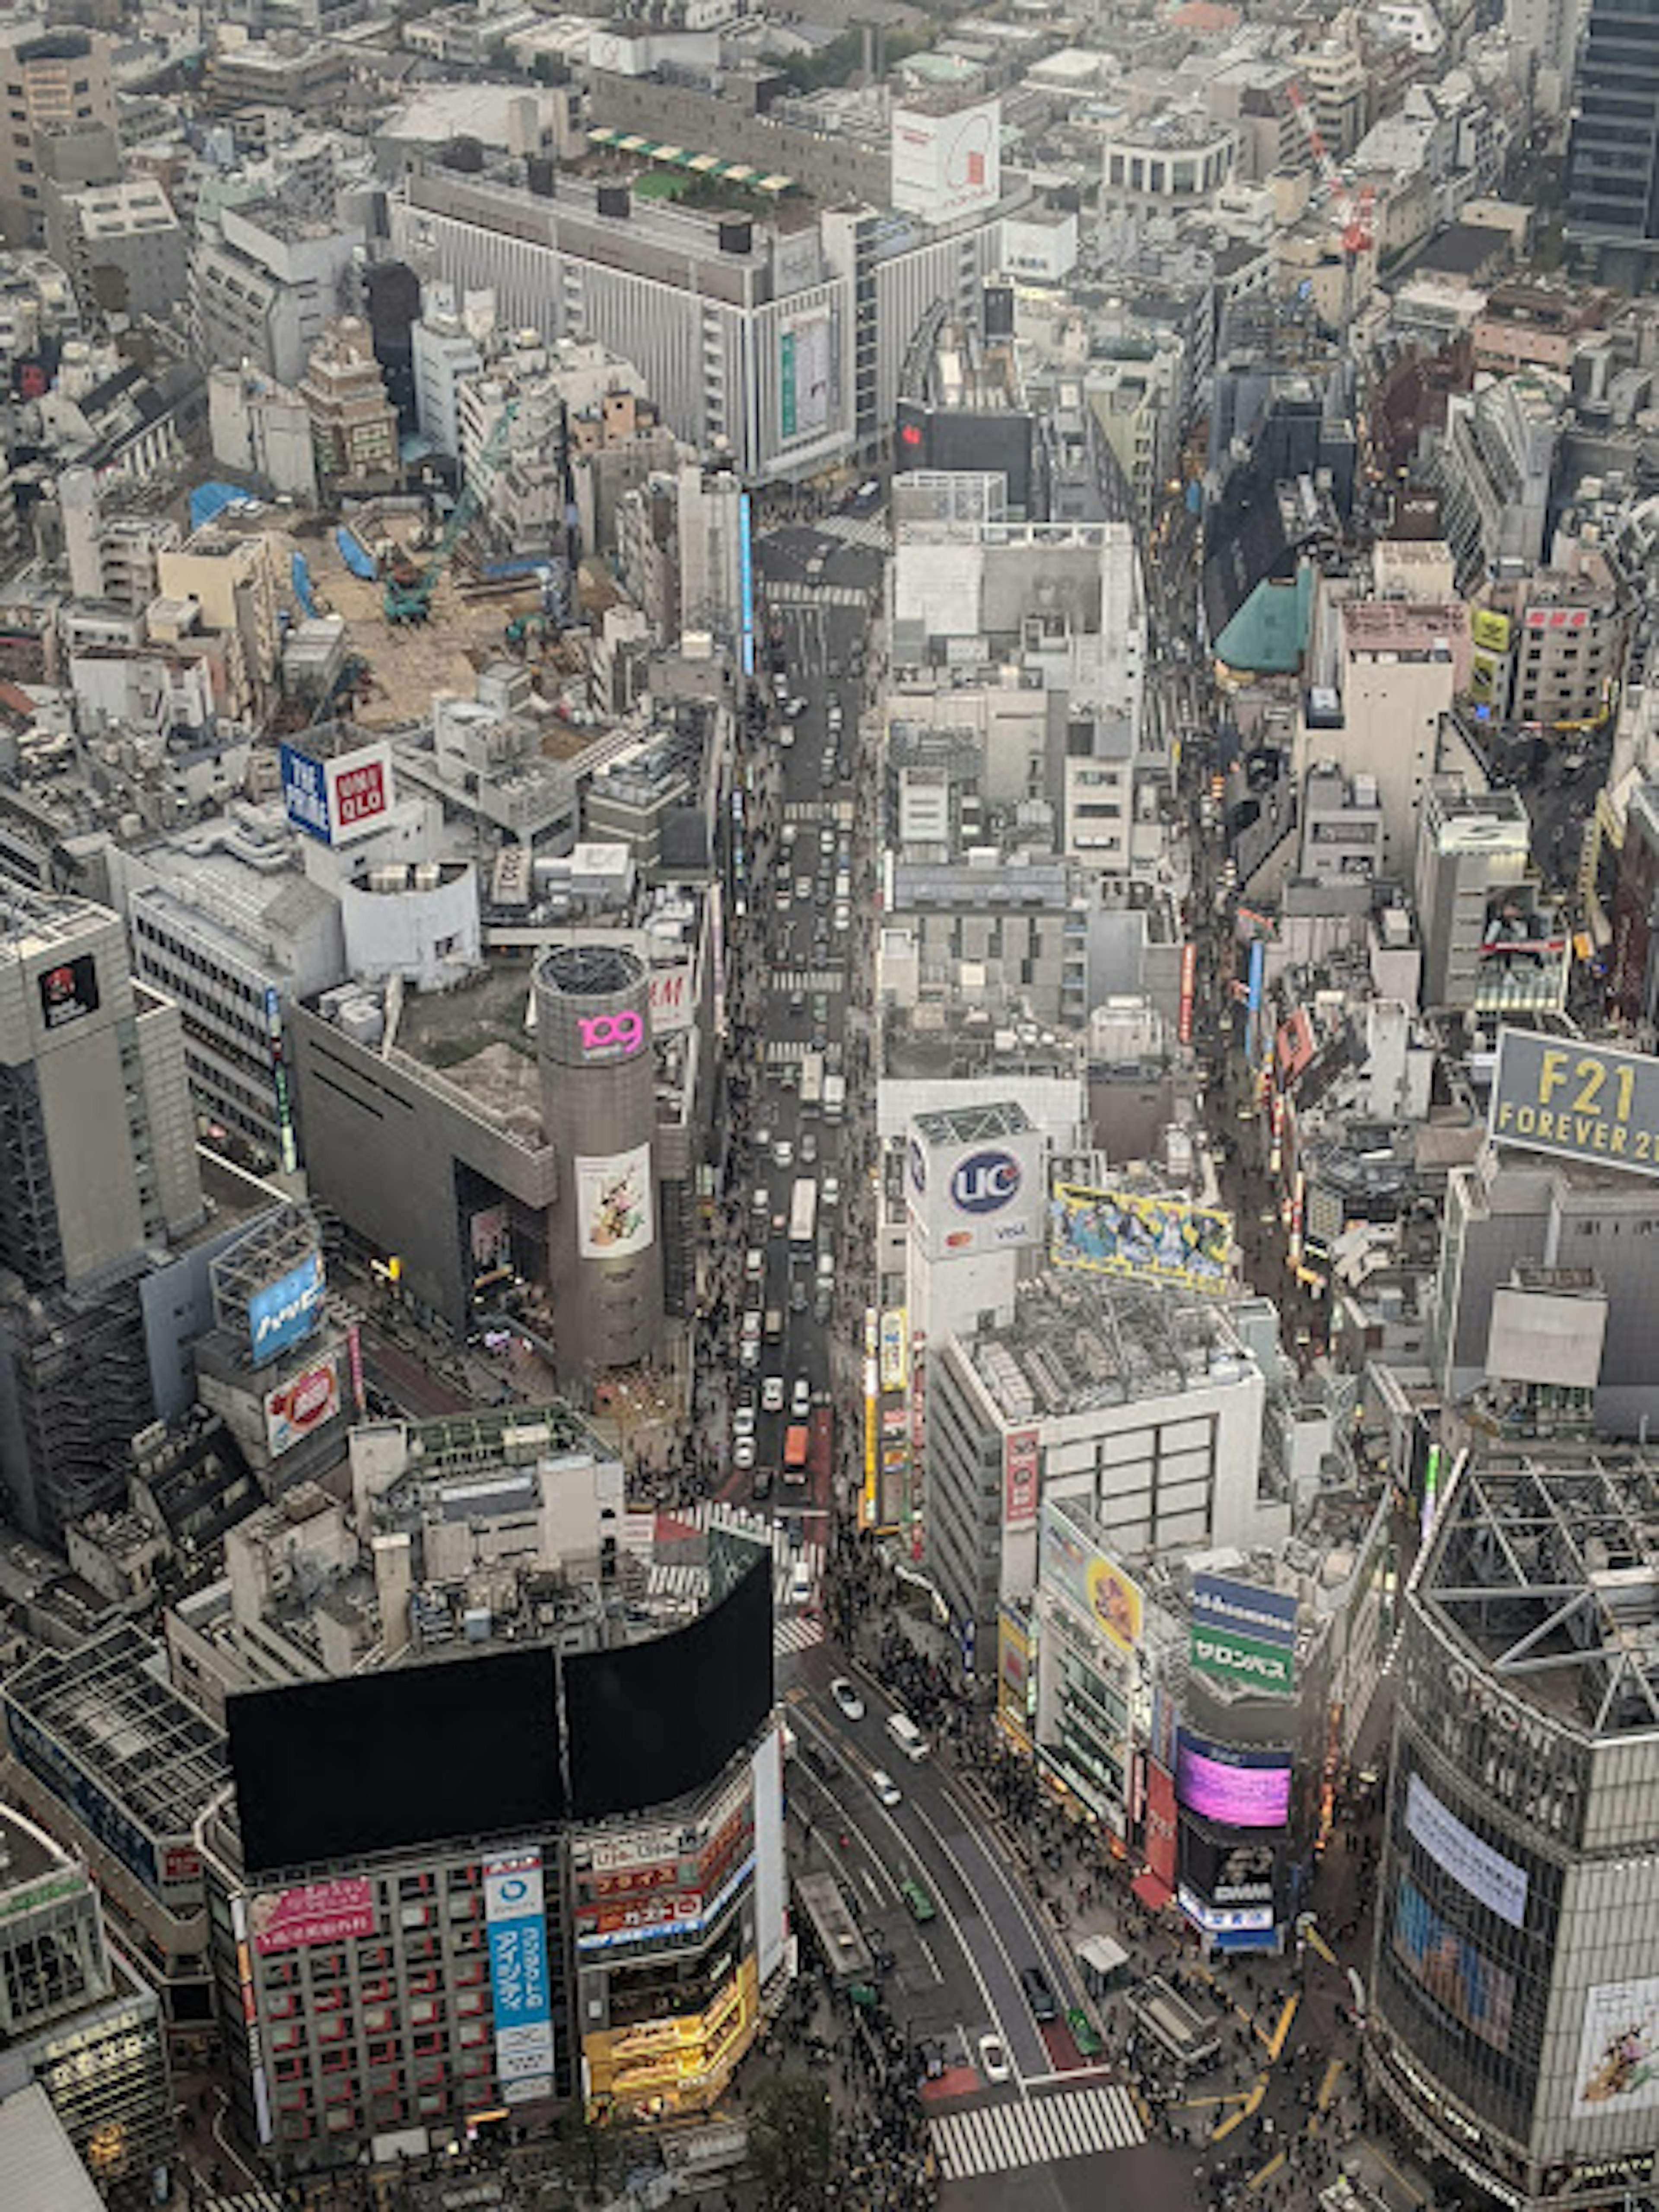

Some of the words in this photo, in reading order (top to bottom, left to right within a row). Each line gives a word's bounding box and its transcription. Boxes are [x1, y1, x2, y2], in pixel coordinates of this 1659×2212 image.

[342, 791, 382, 820] QLO
[575, 1010, 643, 1053] 109
[1538, 1050, 1635, 1122] F21
[1500, 1101, 1627, 1154] FOREVER
[956, 1163, 1015, 1200] UC
[1196, 1639, 1289, 1681] サロンパス
[622, 1903, 676, 1927] ガスト
